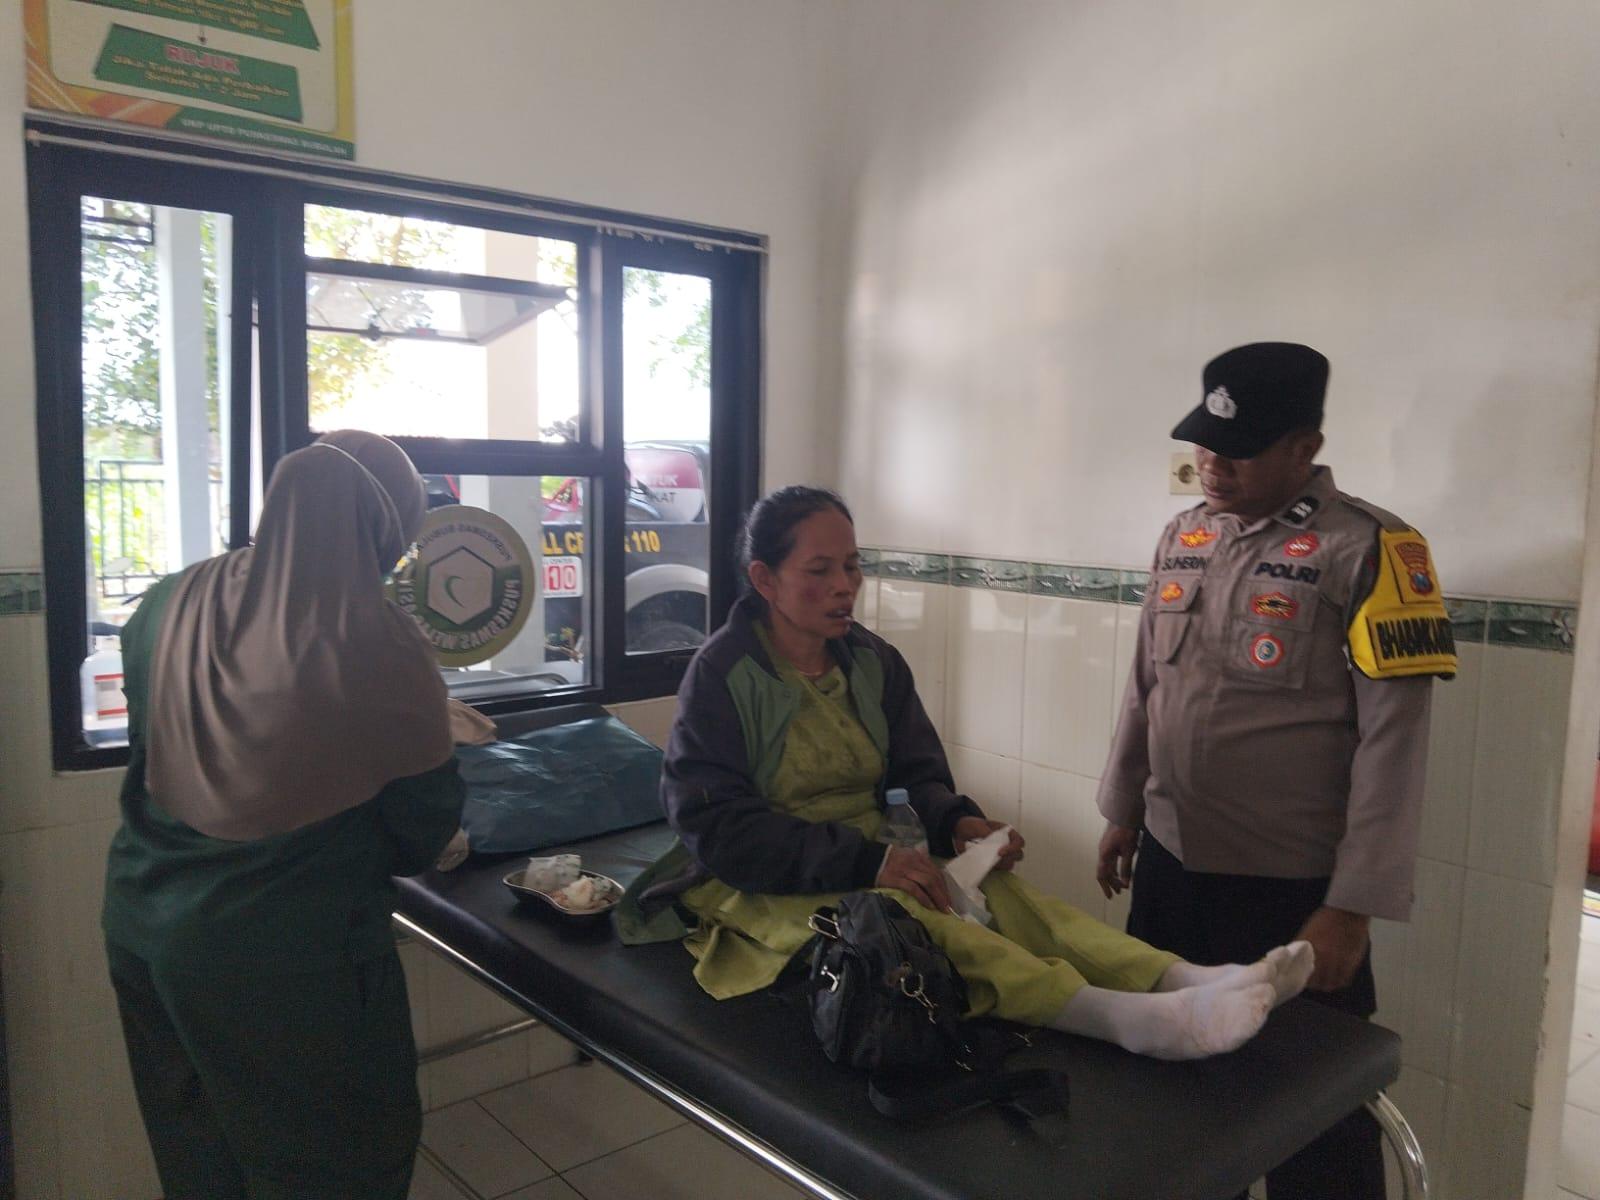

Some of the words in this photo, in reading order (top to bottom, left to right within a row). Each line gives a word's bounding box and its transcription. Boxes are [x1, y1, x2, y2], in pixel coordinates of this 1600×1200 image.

[632, 530, 661, 553] 110
[544, 565, 577, 590] 10
[1254, 561, 1321, 584] POLRI
